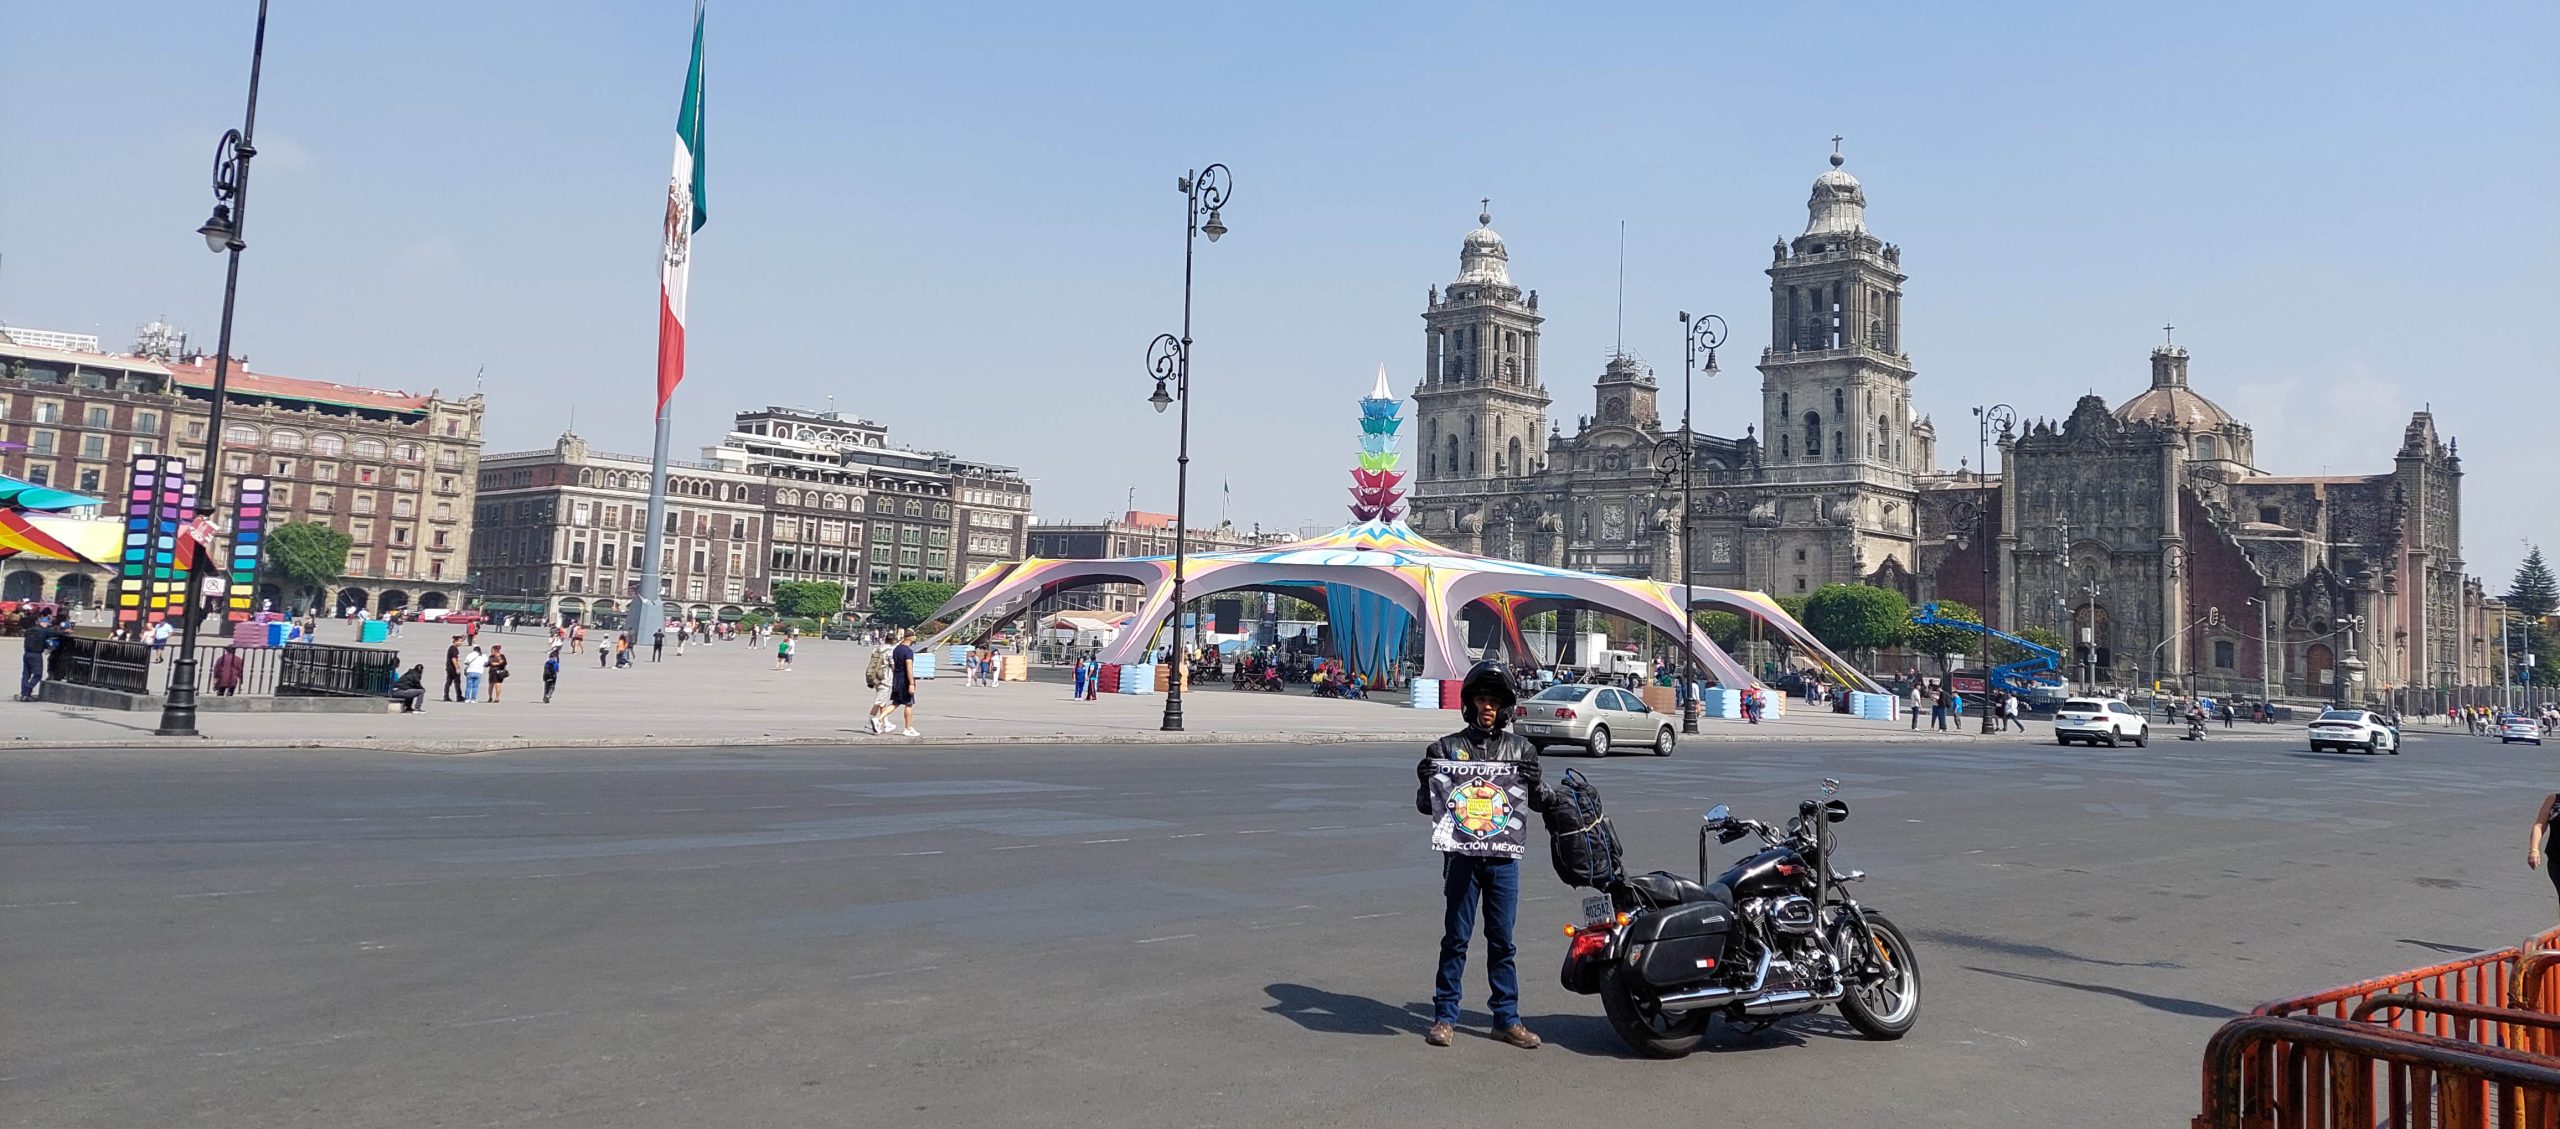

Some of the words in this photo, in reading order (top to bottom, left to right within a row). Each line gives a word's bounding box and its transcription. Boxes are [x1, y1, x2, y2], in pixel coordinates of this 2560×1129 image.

[1438, 766, 1519, 776] OTOTURIST
[1451, 840, 1488, 850] ACCIÓN
[1492, 842, 1525, 853] MÉXICO
[1586, 902, 1610, 919] 4025A2
